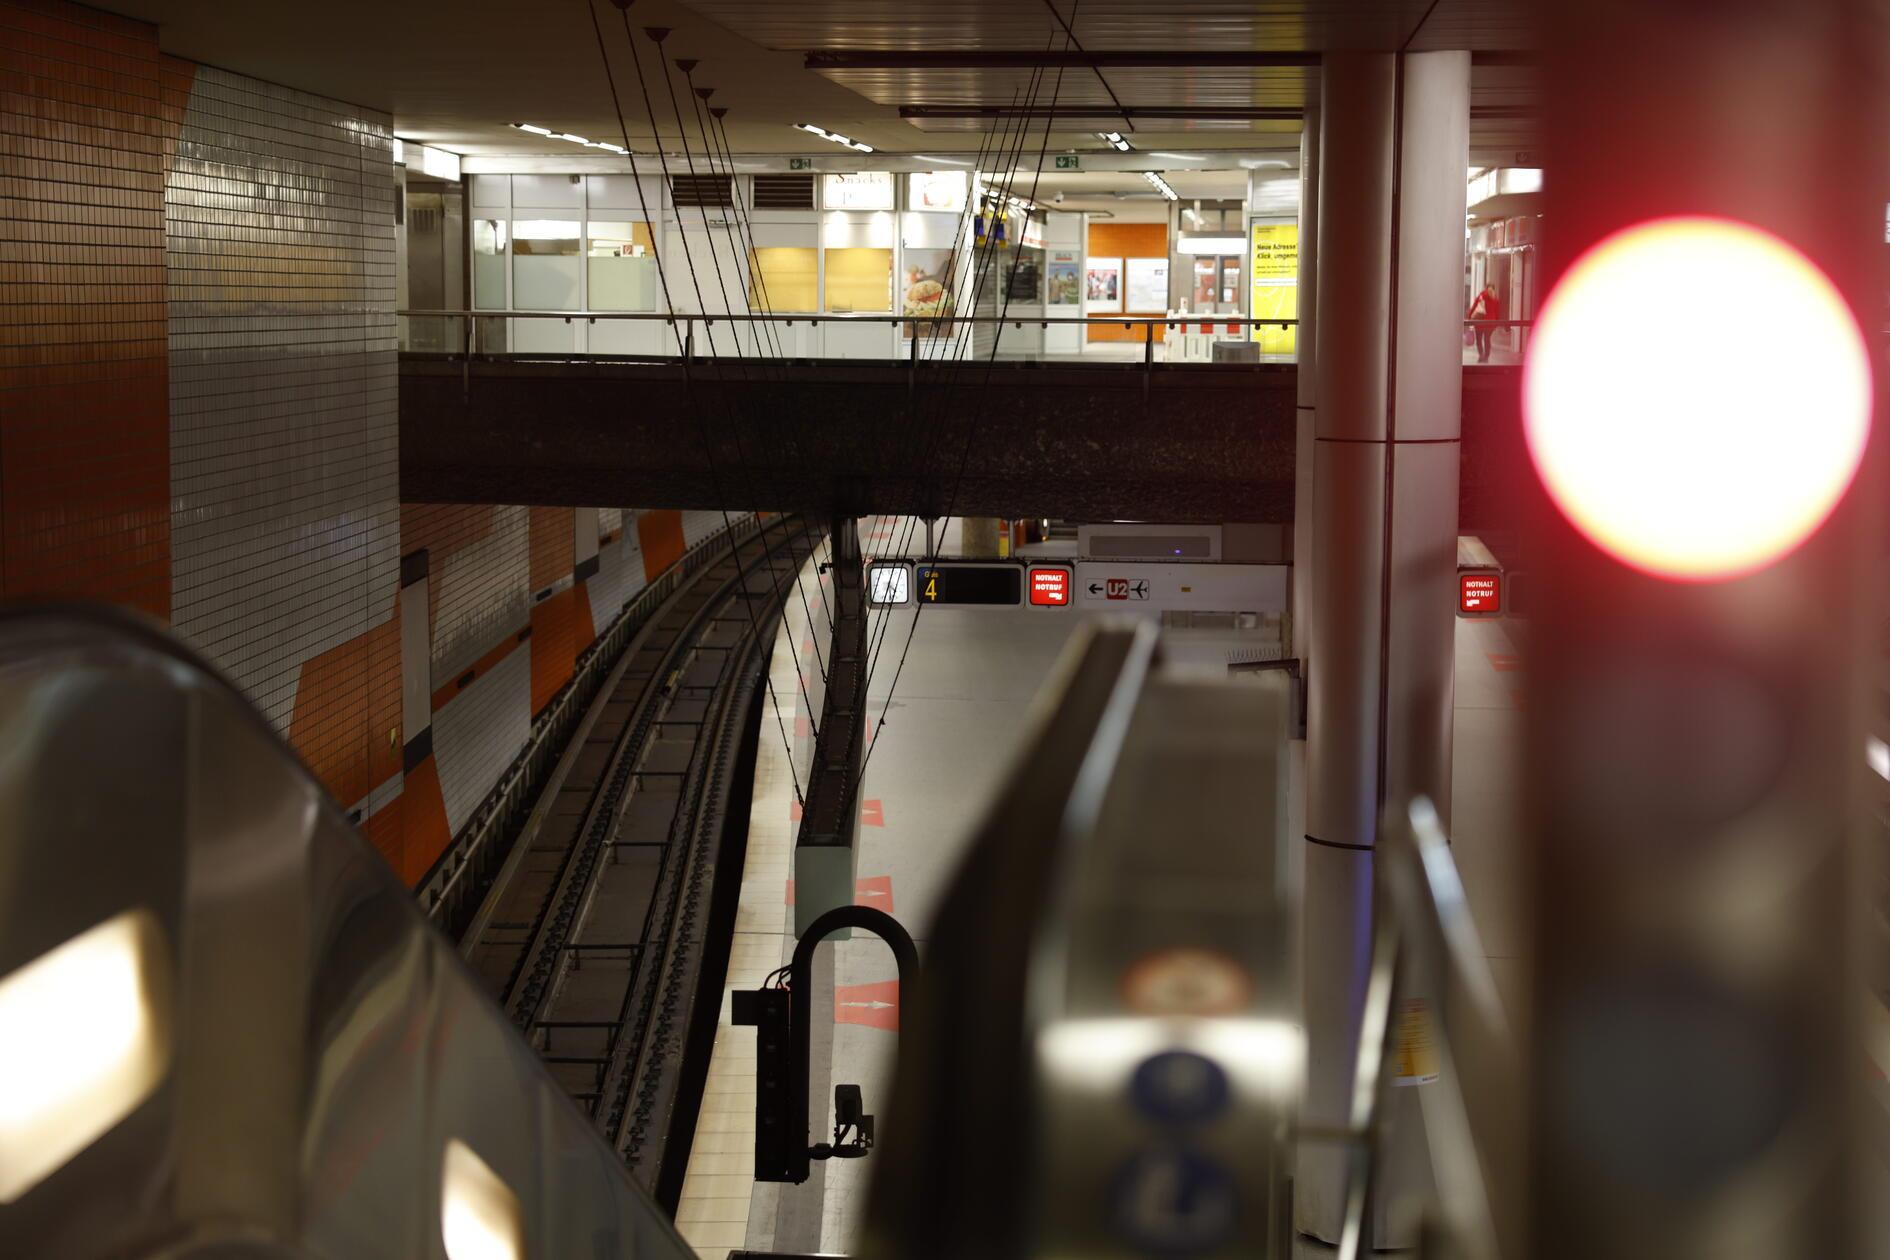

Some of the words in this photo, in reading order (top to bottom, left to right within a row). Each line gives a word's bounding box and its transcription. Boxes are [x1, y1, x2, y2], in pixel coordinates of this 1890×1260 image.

[1035, 574, 1063, 582] NOTHALT
[924, 578, 937, 601] 4
[1035, 583, 1063, 591] NOTRUF
[1108, 582, 1128, 596] U2
[1465, 590, 1494, 598] NOTRUF
